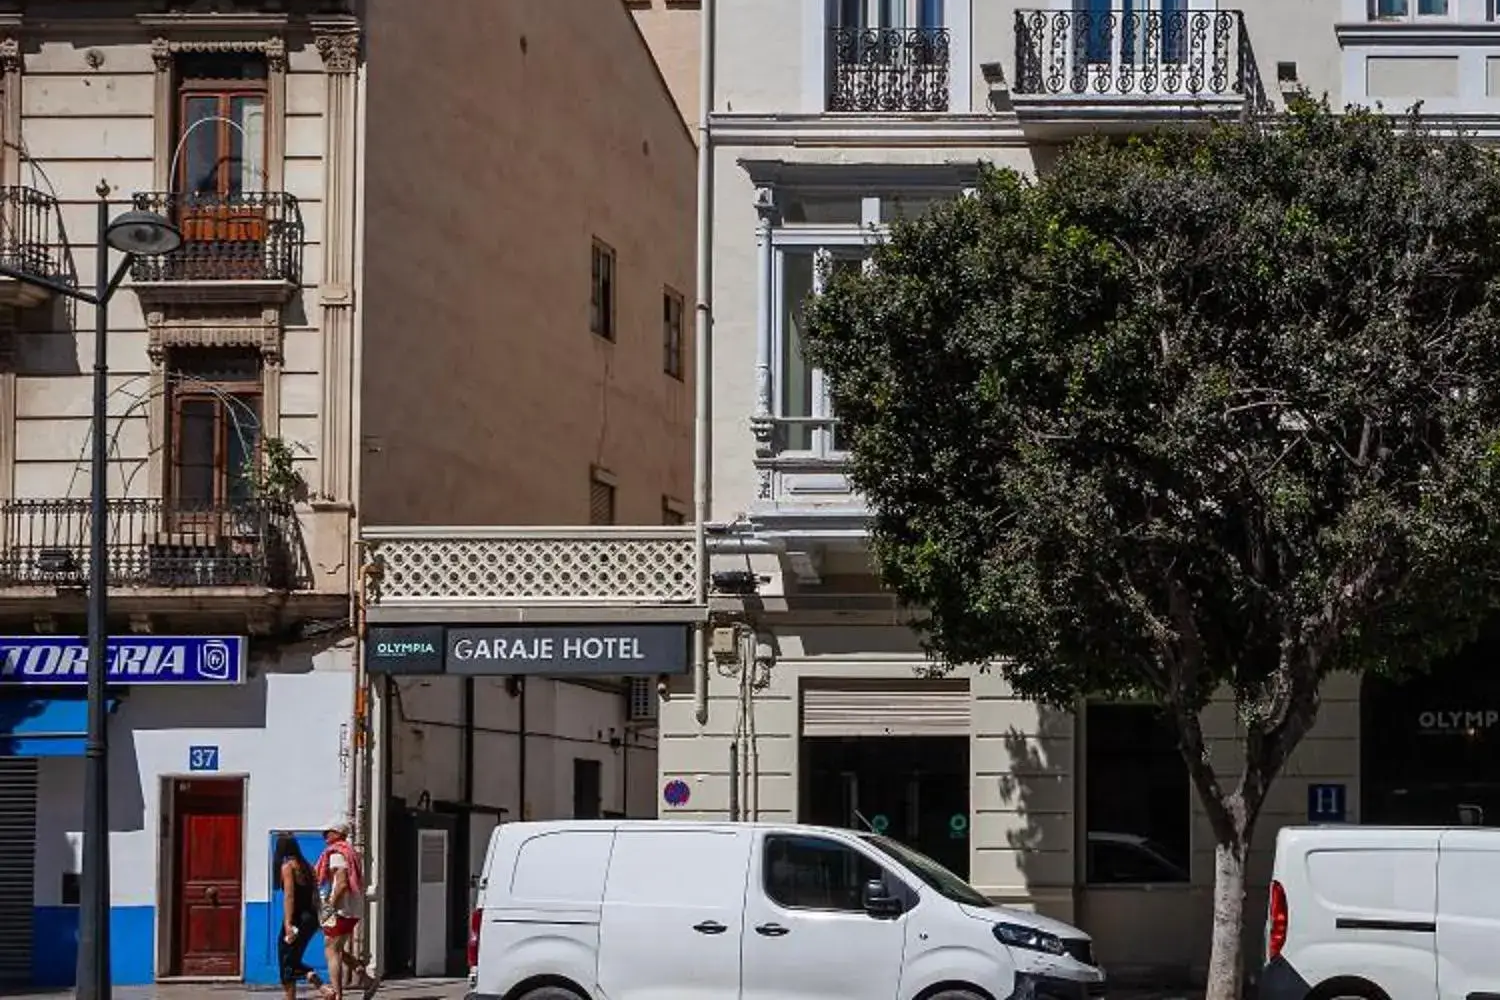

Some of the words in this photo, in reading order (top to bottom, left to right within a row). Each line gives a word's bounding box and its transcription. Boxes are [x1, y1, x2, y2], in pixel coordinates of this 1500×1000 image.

[376, 643, 434, 653] OLYMPIA
[454, 638, 554, 660] GARAJE
[562, 637, 645, 659] HOTEL
[192, 749, 216, 767] 37
